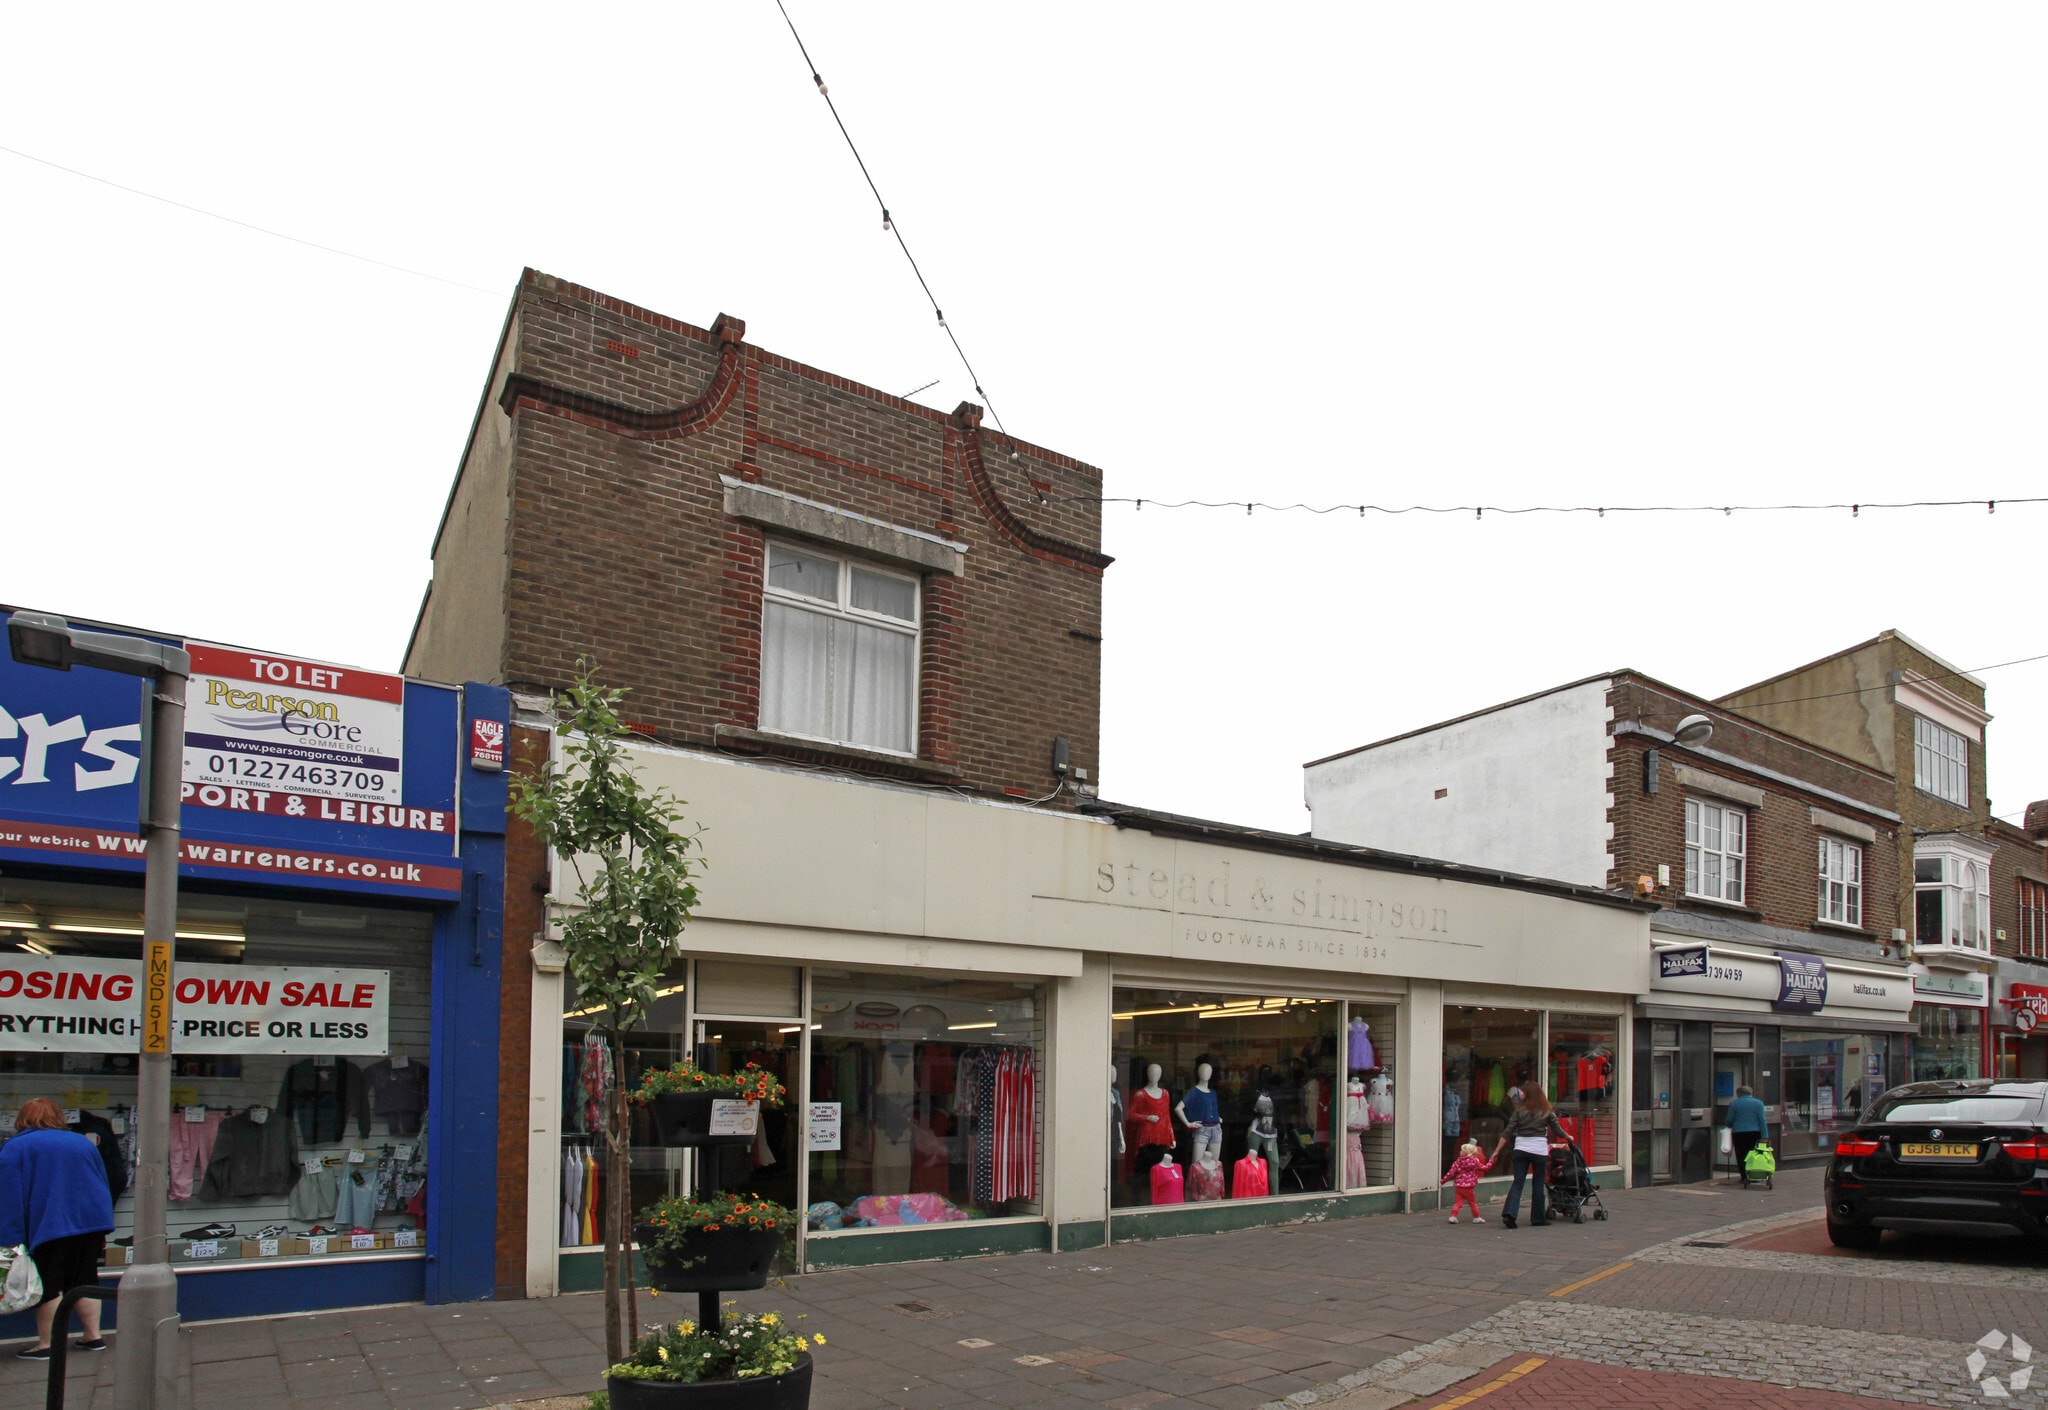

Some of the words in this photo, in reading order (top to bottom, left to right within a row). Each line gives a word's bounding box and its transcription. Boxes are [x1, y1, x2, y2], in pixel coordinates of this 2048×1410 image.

[250, 658, 290, 683] TO
[296, 665, 344, 690] LET
[205, 679, 340, 722] Pearson
[281, 709, 362, 743] Gore
[475, 720, 504, 736] EAGLE
[225, 740, 364, 765] www.pearsongore.co.uk
[299, 737, 383, 755] COMMERCIAL
[474, 751, 502, 761] 768111
[208, 754, 385, 791] 01227463709
[199, 774, 223, 783] SALES
[236, 779, 271, 789] LETTINGS
[283, 784, 333, 796] COMMERCIAL
[344, 791, 385, 802] SURVEYORS
[180, 782, 270, 812] PORT
[284, 795, 306, 816] &
[321, 798, 445, 833] LEISURE
[29, 834, 91, 848] website
[96, 834, 421, 882] ww.warreners.co.uk
[1096, 861, 1231, 907] stead
[1251, 877, 1274, 912] &
[1292, 878, 1449, 940] simpson
[1185, 928, 1287, 951] FOOTWEAR
[1298, 938, 1344, 956] SINCE
[1354, 945, 1387, 960] 1834
[1663, 957, 1704, 968] HALIFAX
[0, 970, 133, 1001] OSING
[172, 978, 270, 1006] OWN
[280, 982, 376, 1009] SALE
[1786, 973, 1825, 991] HALIFAX
[1853, 983, 1886, 997] halifax.co.uk
[0, 1015, 124, 1035] RYTHING
[183, 1020, 260, 1038] PRICE
[267, 1021, 302, 1038] OR
[309, 1021, 369, 1039] LESS
[1907, 1144, 1941, 1154] GJ58
[1945, 1144, 1971, 1155] TCK
